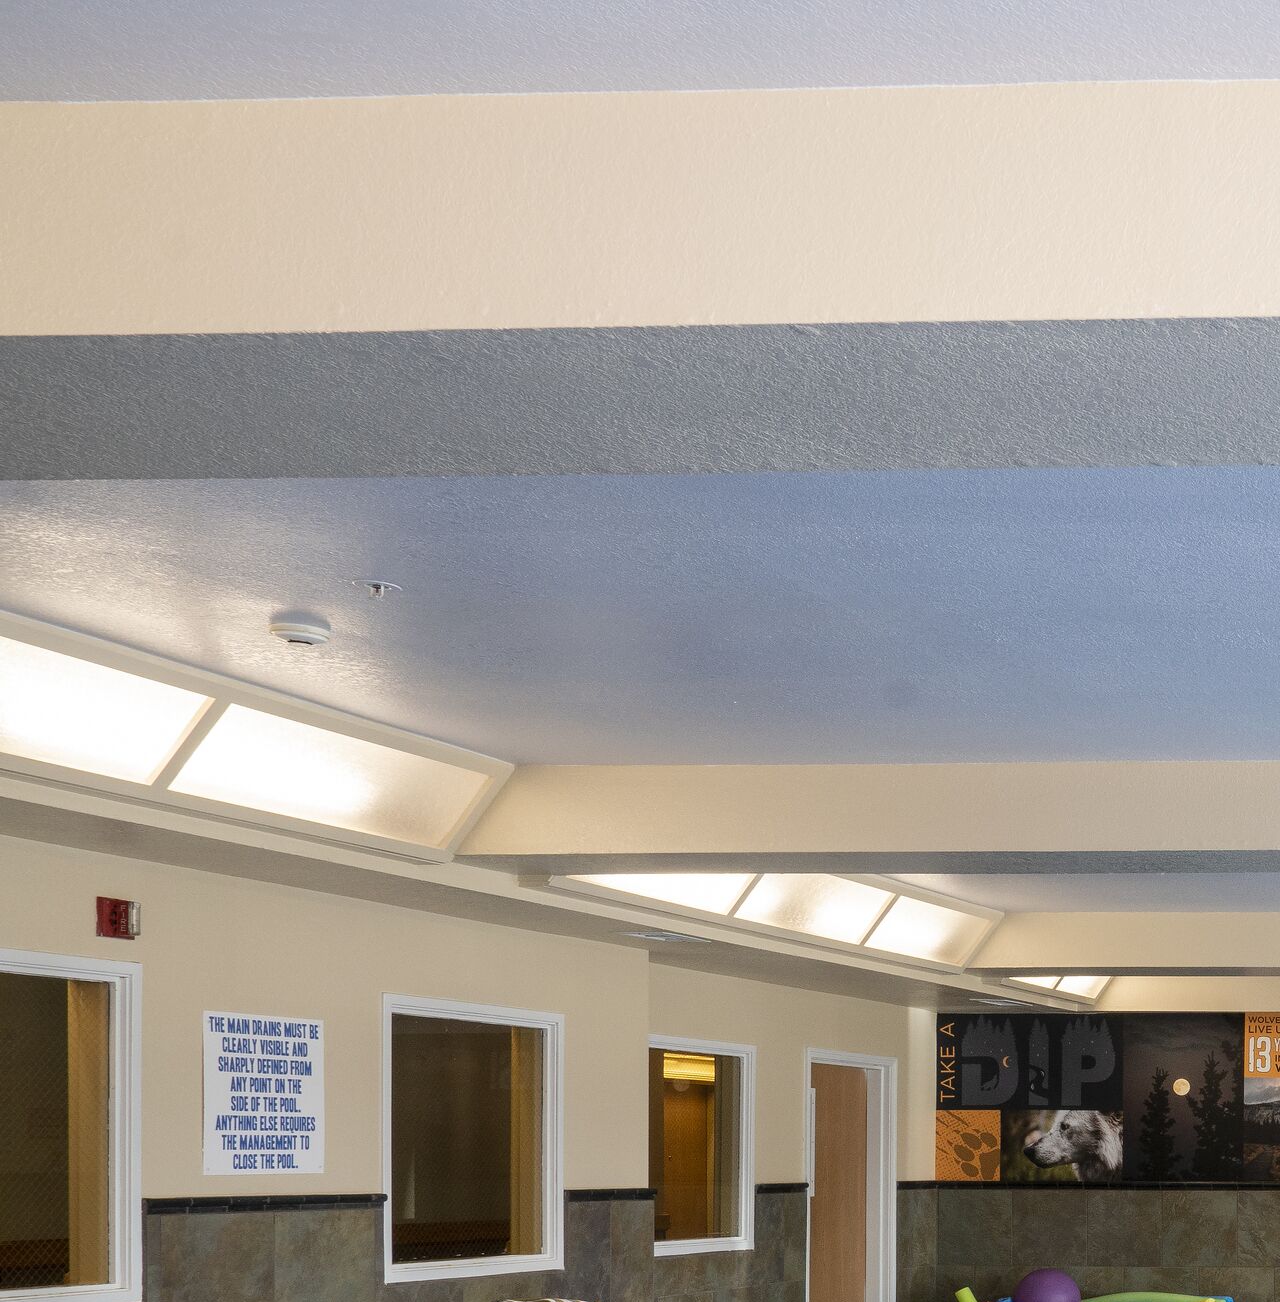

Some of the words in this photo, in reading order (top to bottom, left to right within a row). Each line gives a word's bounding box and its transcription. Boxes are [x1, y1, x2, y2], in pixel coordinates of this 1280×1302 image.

[209, 1016, 225, 1033] THE
[227, 1018, 250, 1035] MAIN
[253, 1020, 282, 1037] DRAINS
[284, 1022, 306, 1038] MUST
[310, 1024, 319, 1040] BE
[939, 1022, 955, 1037] A
[1249, 1026, 1272, 1034] LIVE
[222, 1038, 257, 1054] CLEARLY
[260, 1040, 289, 1056] VISIBLE
[292, 1042, 308, 1057] AND
[1248, 1036, 1271, 1073] 13
[218, 1057, 254, 1073] SHARPLY
[258, 1059, 288, 1075] DEFINED
[290, 1061, 312, 1076] FROM
[940, 1046, 955, 1102] TAKE
[230, 1077, 247, 1092] ANY
[250, 1078, 272, 1093] POINT
[275, 1079, 285, 1093] ON
[288, 1079, 302, 1094] THE
[231, 1096, 248, 1111] SIDE
[251, 1097, 261, 1112] OF
[263, 1097, 278, 1112] THE
[280, 1098, 301, 1112] POOL.
[216, 1115, 258, 1131] ANYTHING
[260, 1116, 278, 1131] ELSE
[280, 1116, 315, 1133] REQUIRES
[222, 1135, 237, 1150] THE
[240, 1135, 297, 1150] MANAGEMENT
[300, 1135, 310, 1150] TO
[233, 1154, 258, 1169] CLOSE
[260, 1154, 275, 1169] THE
[277, 1154, 298, 1169] POOL.
